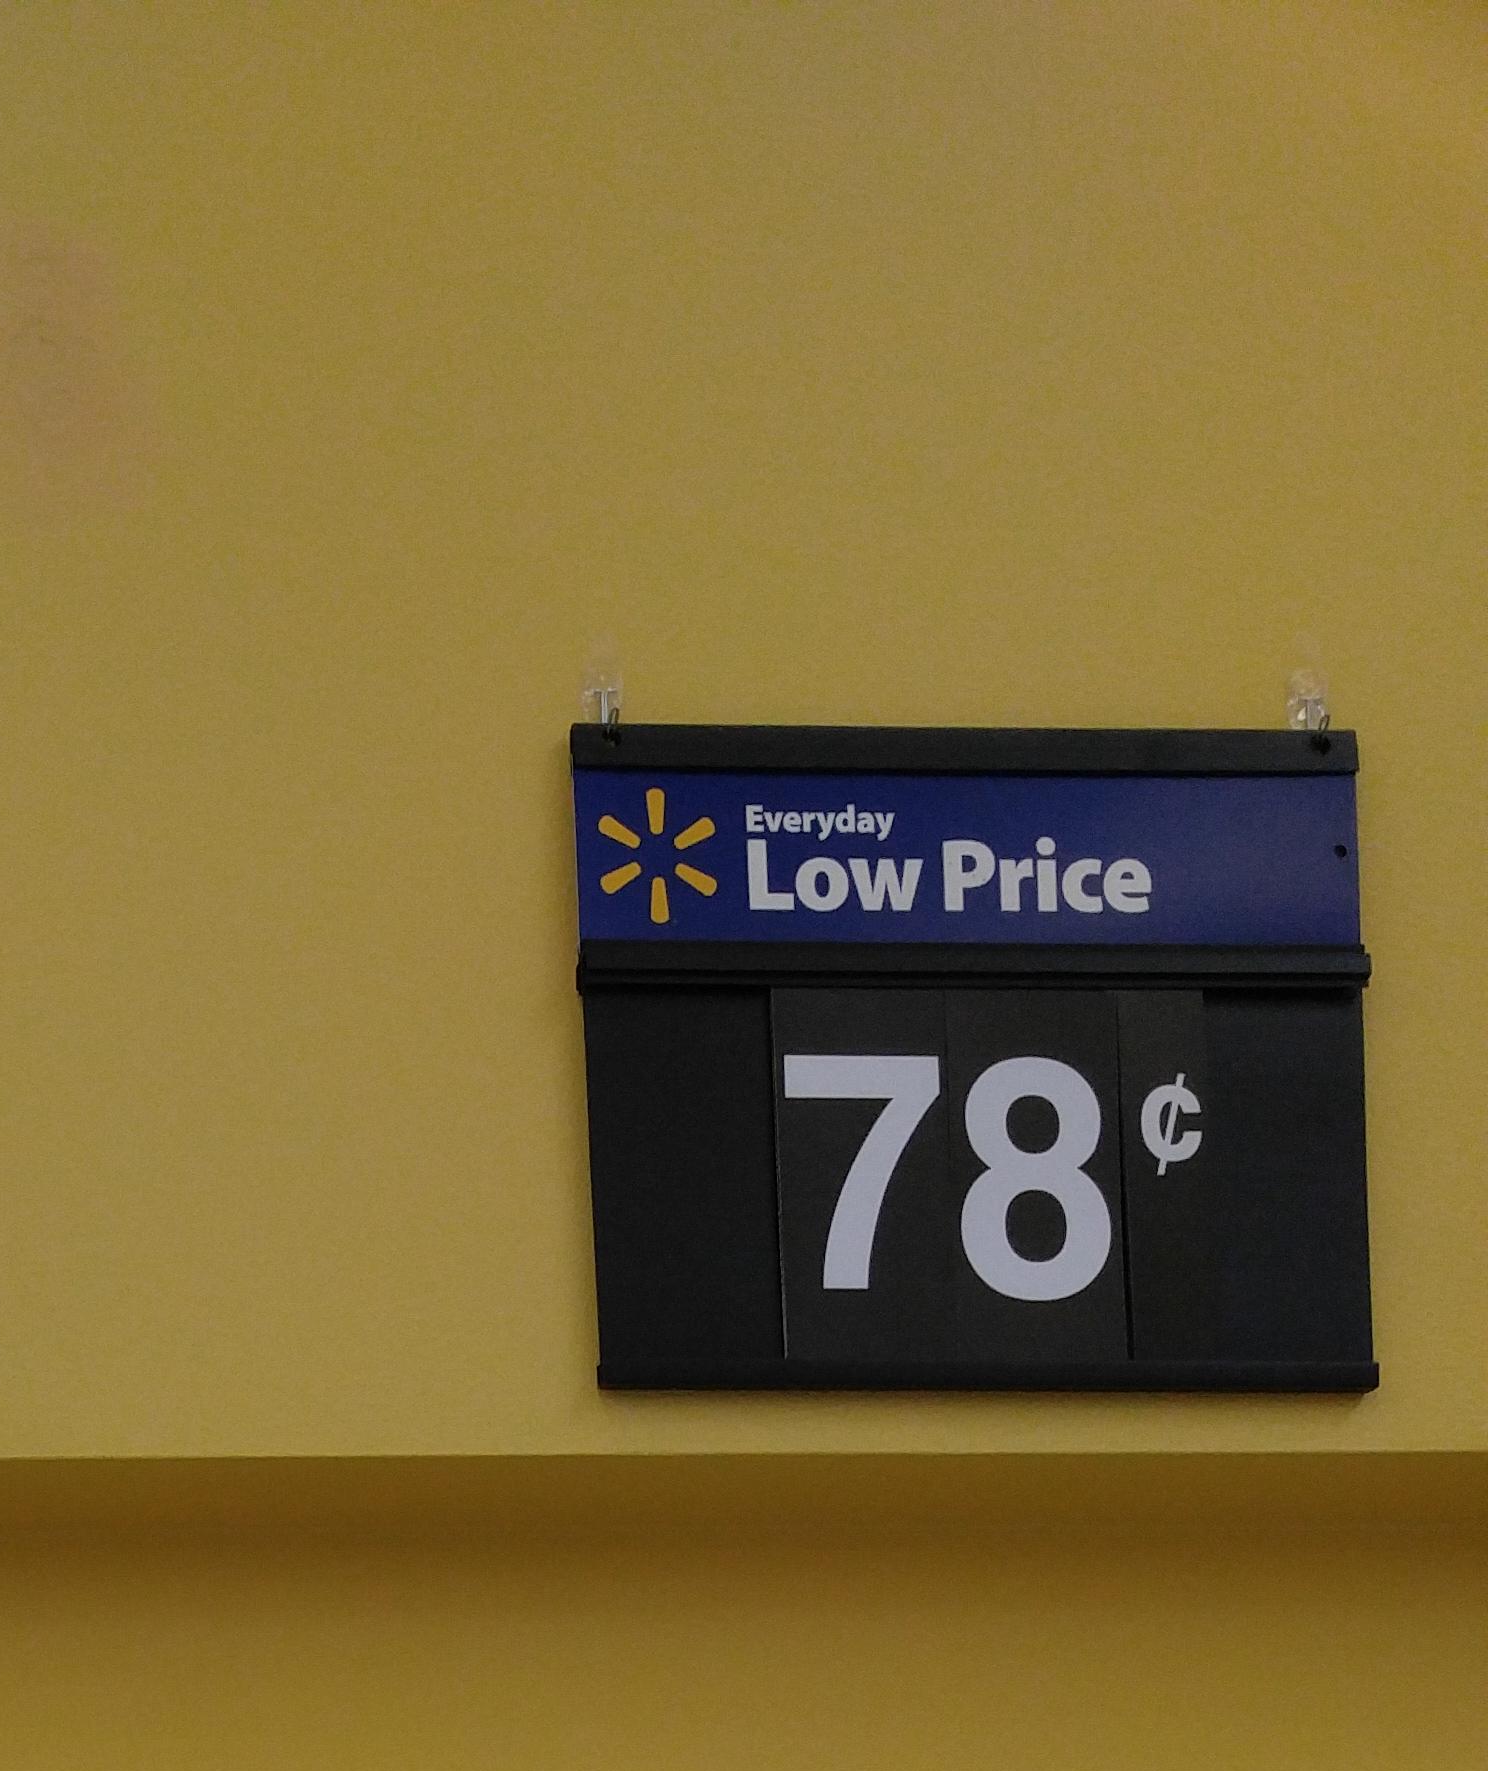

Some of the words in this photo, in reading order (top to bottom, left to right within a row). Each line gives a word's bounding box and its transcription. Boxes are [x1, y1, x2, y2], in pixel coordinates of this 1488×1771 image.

[744, 804, 897, 841] Everyday
[747, 839, 923, 912] Low
[942, 837, 1154, 914] Price
